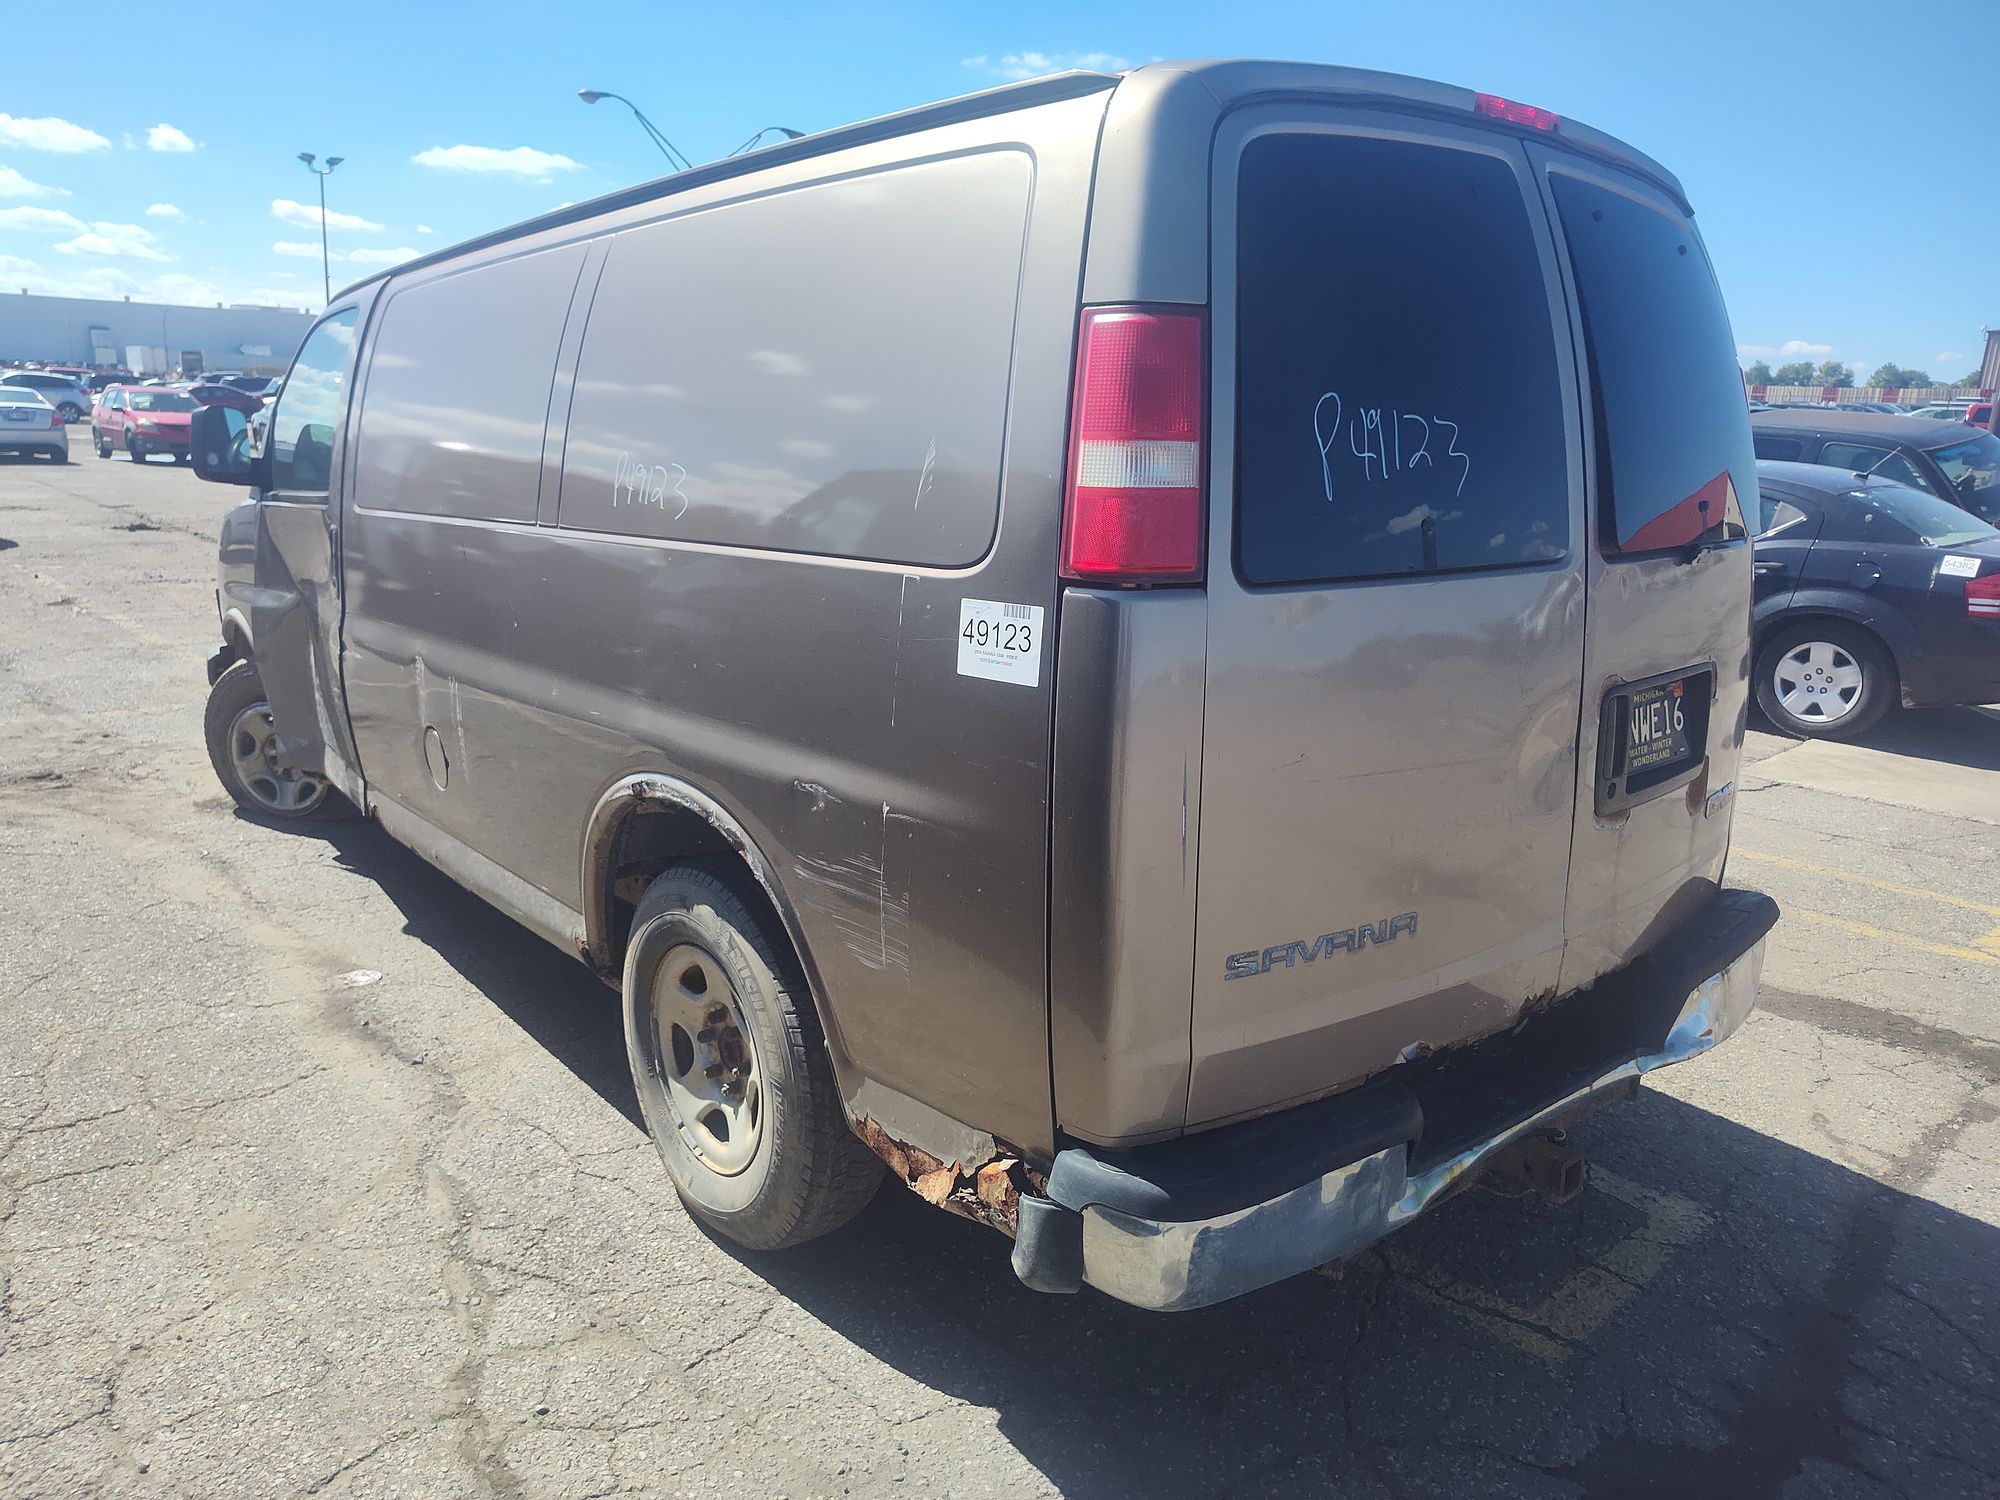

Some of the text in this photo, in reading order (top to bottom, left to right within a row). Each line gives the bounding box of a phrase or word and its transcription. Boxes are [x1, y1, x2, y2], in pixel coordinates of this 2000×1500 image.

[962, 617, 1032, 653] 49123
[1632, 749, 1671, 768] WONDERLAND
[1224, 911, 1418, 981] SAVANA
